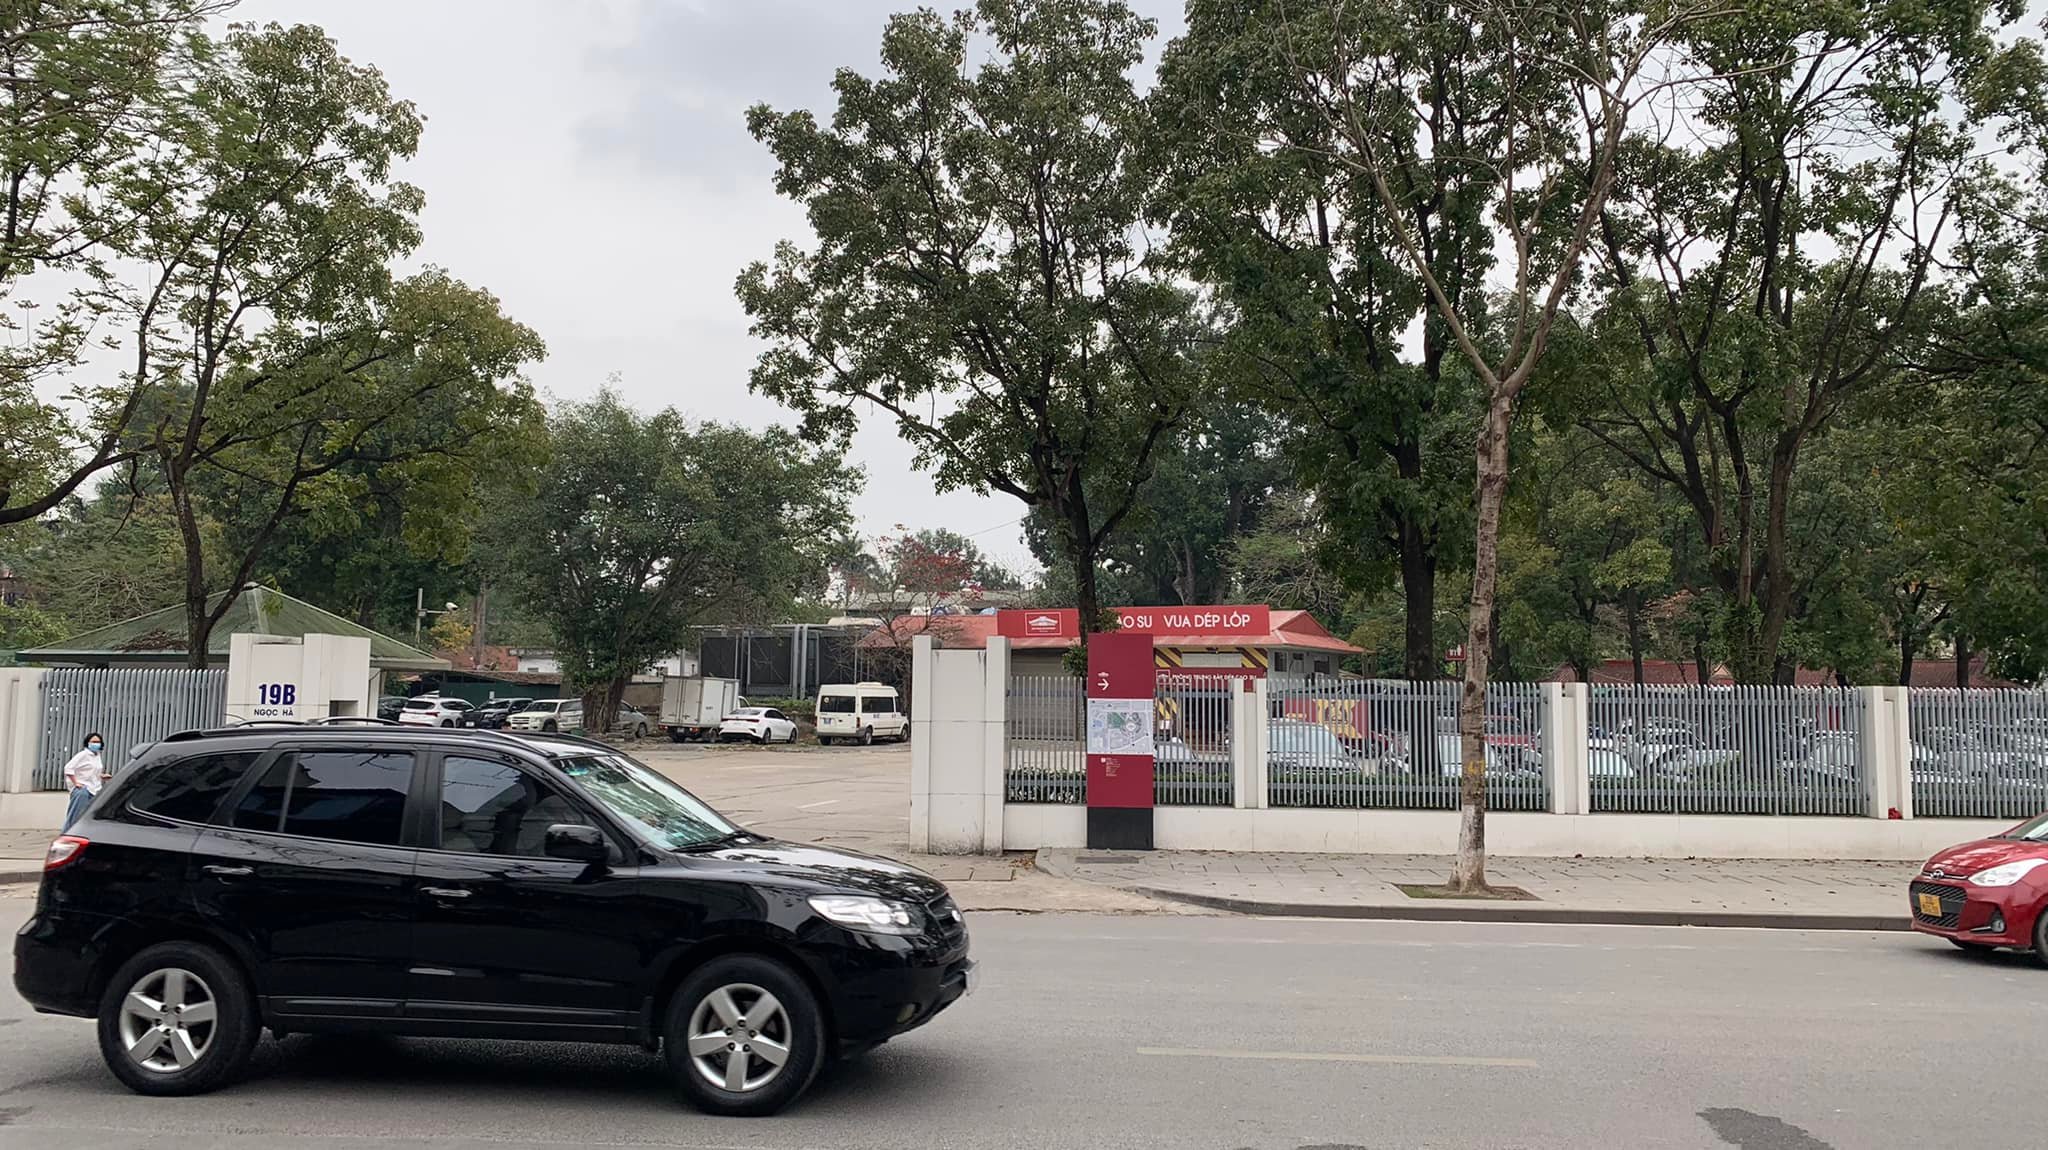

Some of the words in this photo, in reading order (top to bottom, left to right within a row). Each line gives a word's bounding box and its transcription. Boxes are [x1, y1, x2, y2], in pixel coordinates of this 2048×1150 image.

[1137, 615, 1153, 628] SU
[1163, 615, 1191, 628] VUA
[1195, 612, 1220, 628] DÉP
[258, 684, 296, 705] 19B
